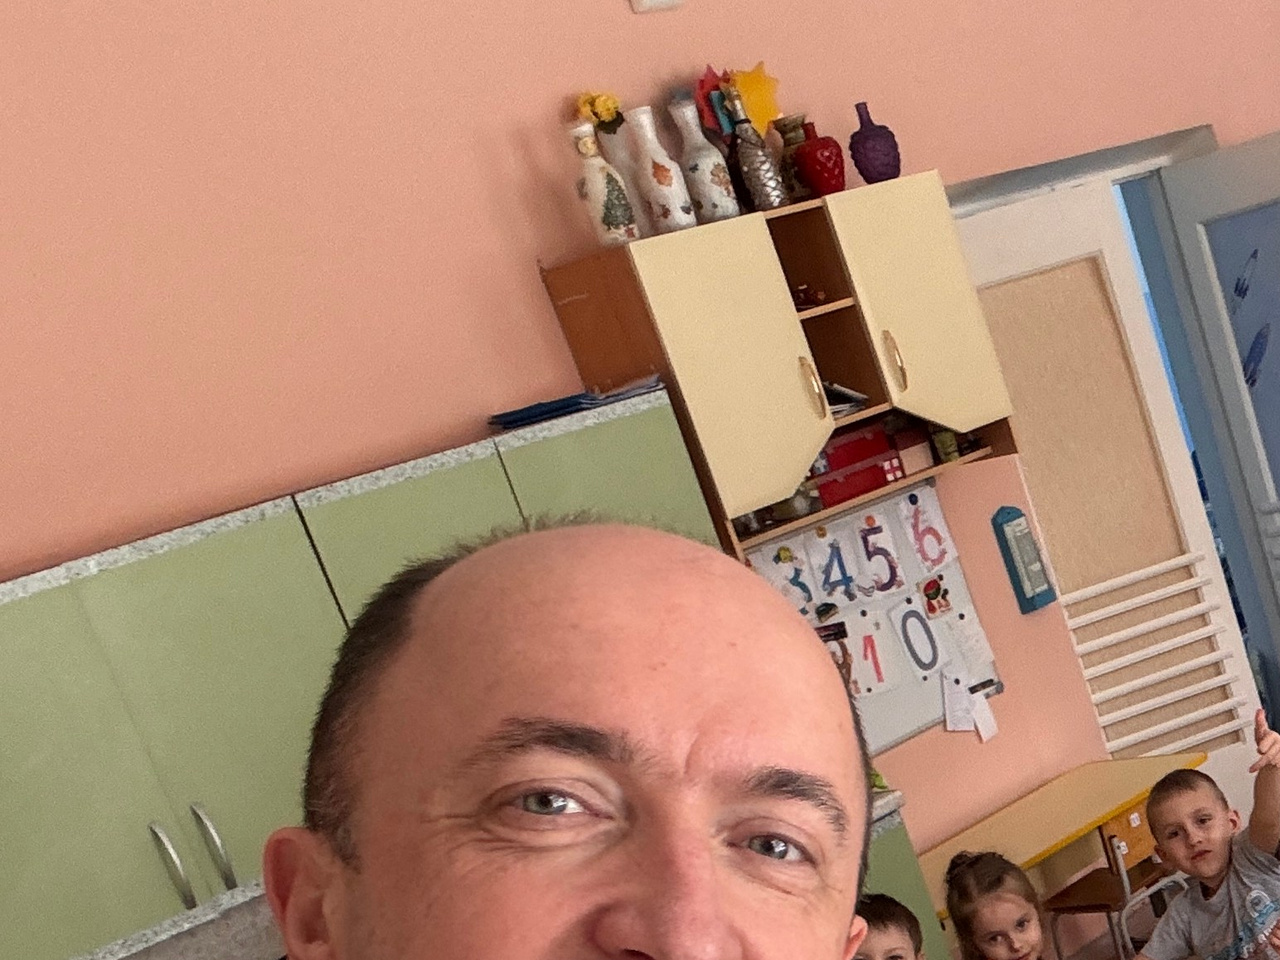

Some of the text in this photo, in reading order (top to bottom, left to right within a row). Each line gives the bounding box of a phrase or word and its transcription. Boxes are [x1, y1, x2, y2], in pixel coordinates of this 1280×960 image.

[822, 539, 857, 601] 4
[859, 525, 901, 592] 5
[912, 507, 947, 567] 6
